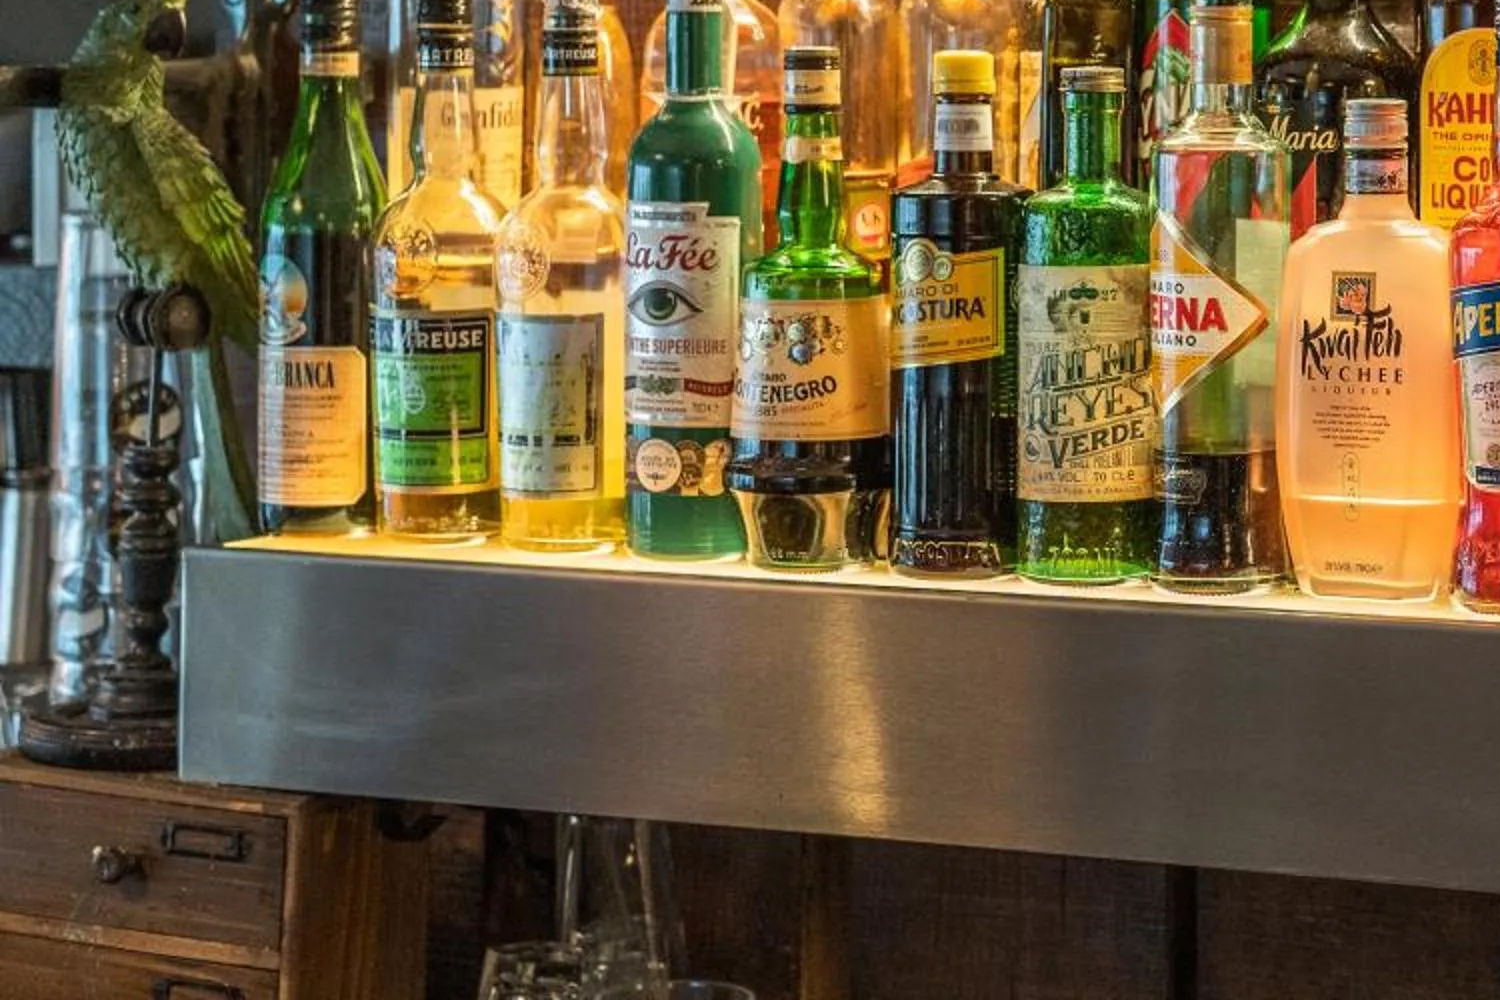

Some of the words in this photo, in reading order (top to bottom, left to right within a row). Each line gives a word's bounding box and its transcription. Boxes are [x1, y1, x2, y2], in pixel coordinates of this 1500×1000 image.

[419, 45, 474, 65] ARTRE
[1427, 90, 1495, 128] KAH
[1268, 113, 1338, 152] Maria
[1431, 130, 1457, 141] THE
[1431, 183, 1486, 210] LIQU
[655, 234, 720, 271] Fée
[942, 283, 959, 295] DI
[1152, 295, 1229, 333] ERNA
[652, 338, 728, 355] SUPERIEURE
[1299, 313, 1360, 376] Kwai
[1307, 365, 1405, 385] LYCHEE
[1027, 377, 1152, 435] REYES
[1048, 418, 1145, 469] VERDE
